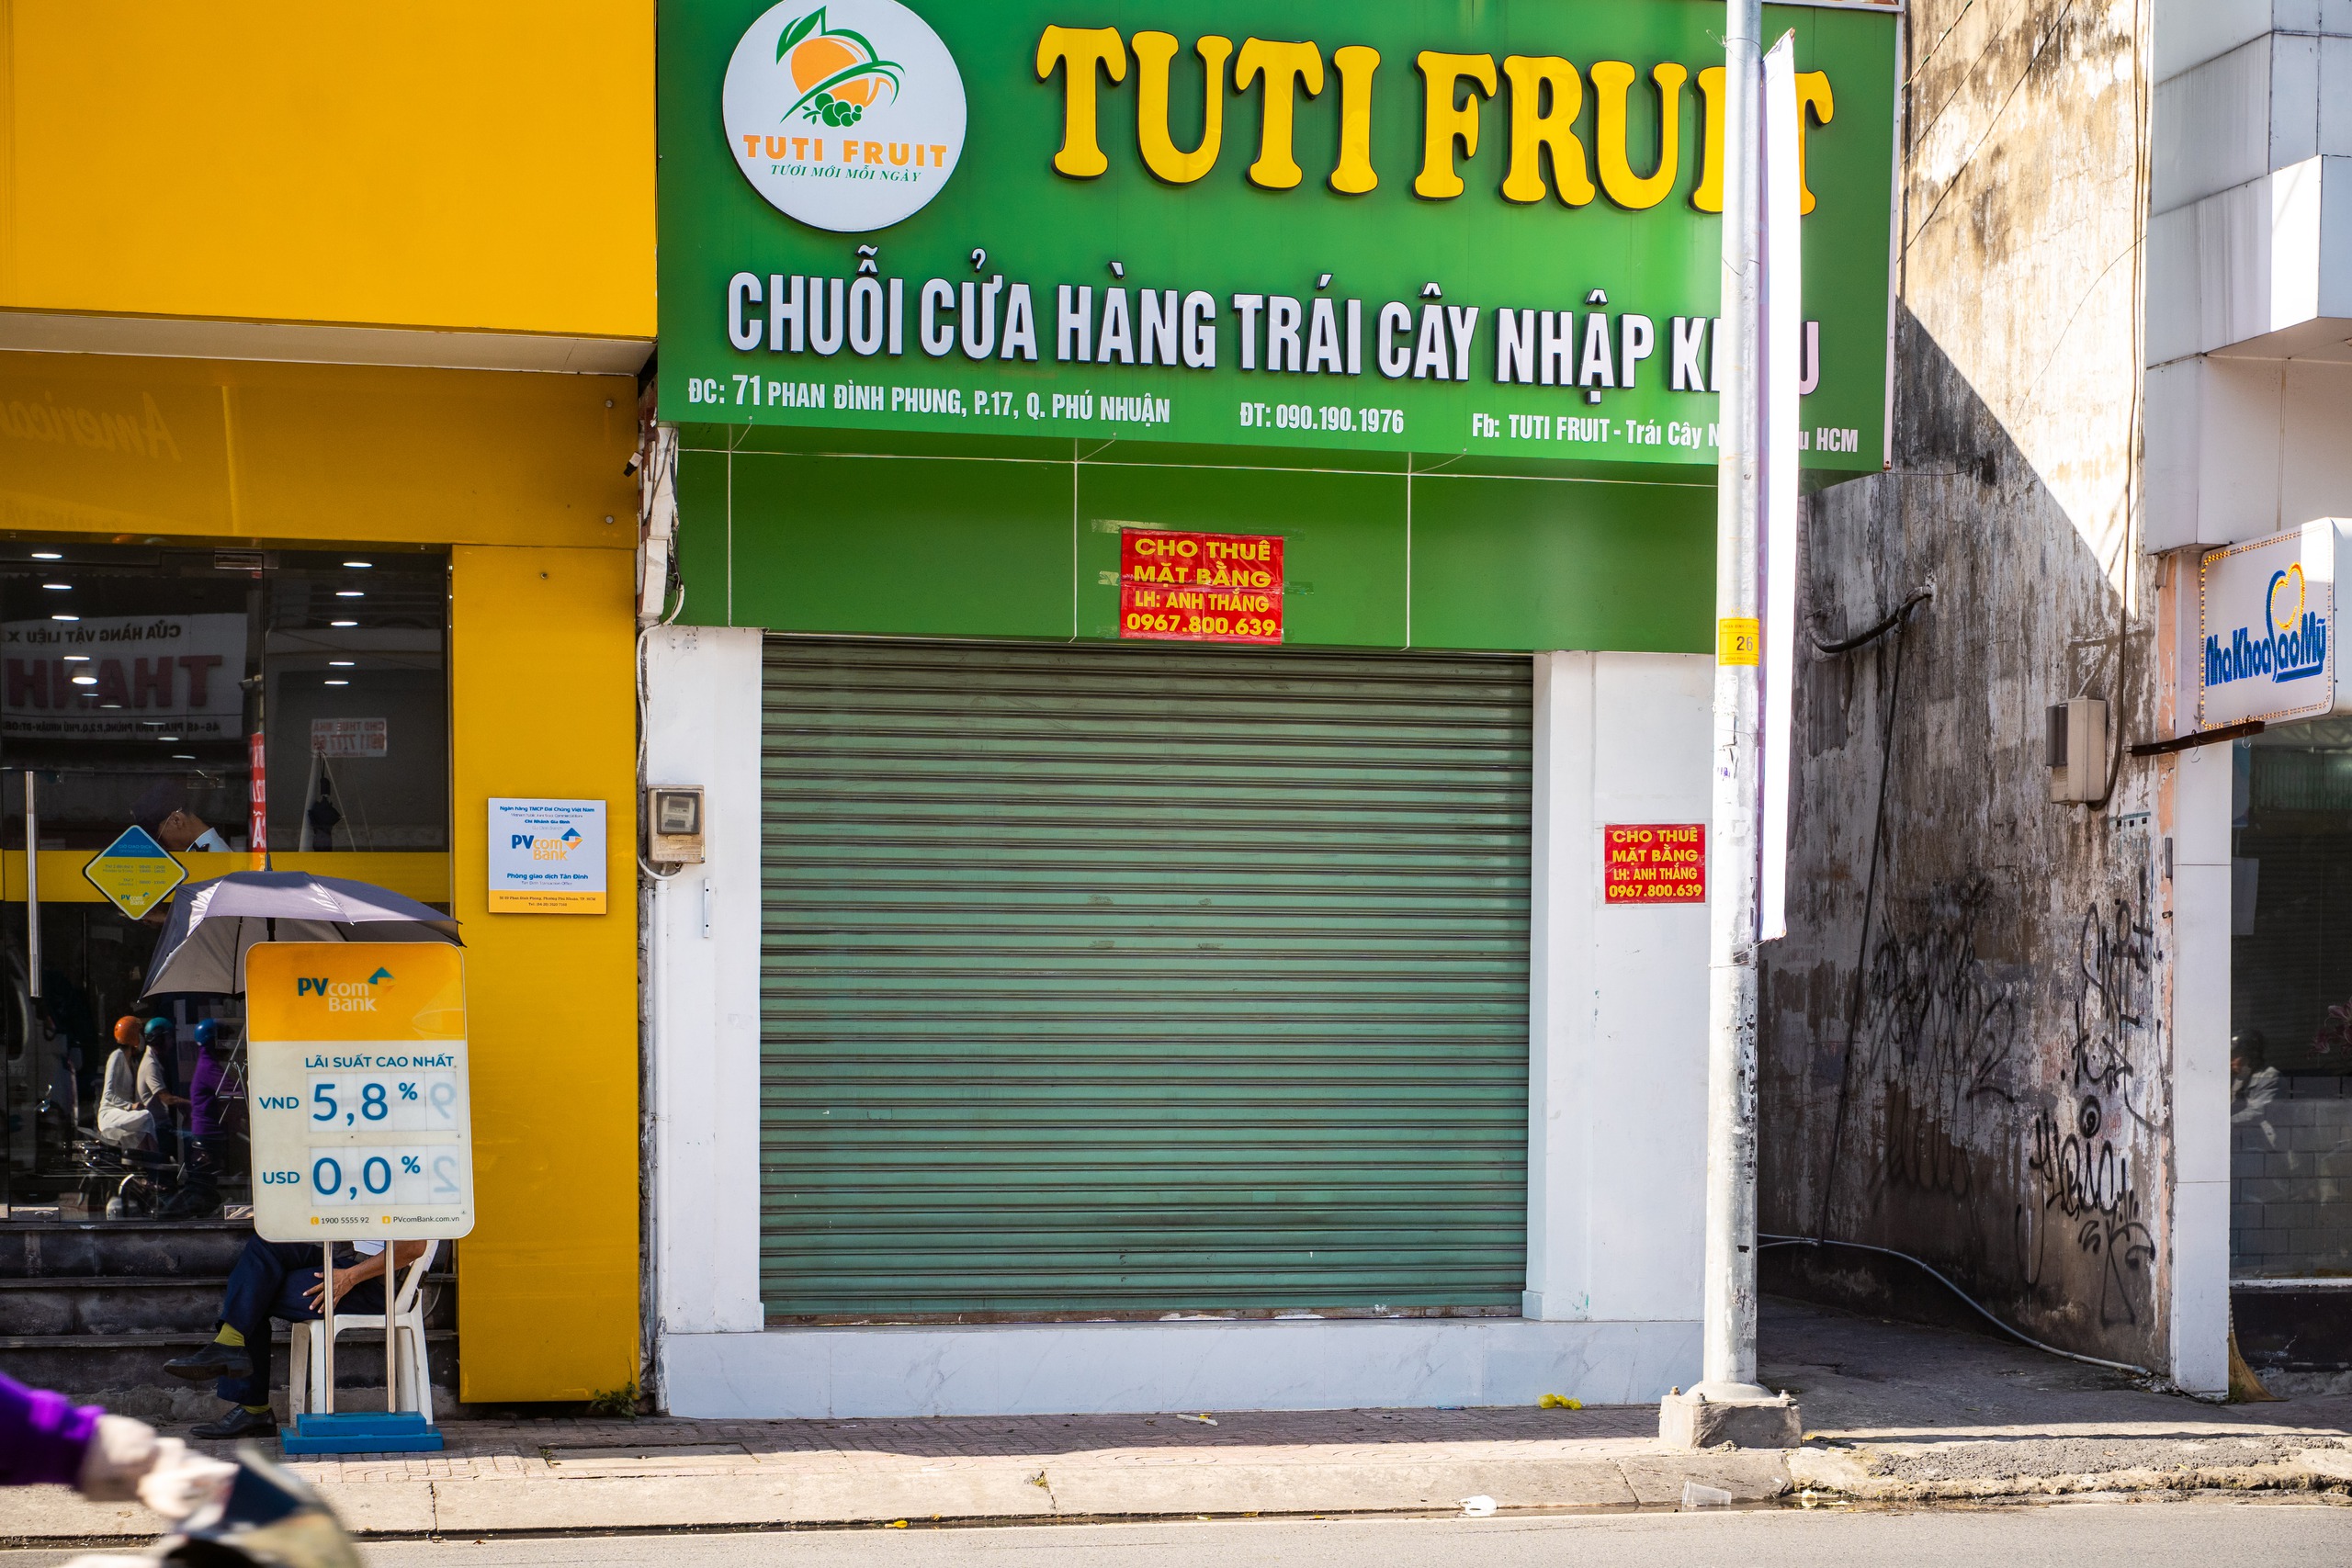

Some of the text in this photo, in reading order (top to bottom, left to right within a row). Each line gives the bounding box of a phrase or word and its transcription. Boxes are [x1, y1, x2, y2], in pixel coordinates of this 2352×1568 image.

[1035, 25, 1380, 194] TUTI
[743, 135, 947, 167] TUTI FRUIT
[771, 164, 922, 183] TƯƠI MỚI MỖI NGÀY
[728, 244, 1820, 404] CHUỖI CỬA HÀNG TRÁI CÂY NHẬP KU
[688, 374, 1170, 427] ĐC: 71 PHAN ĐÌNH PHUNG, P.17, Q. PHÚ NHUẬN
[1239, 401, 1405, 434] ĐT: 090.190.1976
[1472, 412, 1500, 438] Fb:
[1508, 413, 1551, 440] TUTI
[1555, 415, 1611, 443] FRUIT
[1667, 418, 1702, 450] Cây
[1815, 427, 1859, 453] HCM
[1135, 538, 1271, 561] CHO THUÊ
[1133, 560, 1272, 588] MẶT BẰNG
[1135, 587, 1270, 613] LH: ANH THẮNG
[1126, 613, 1276, 636] 0967.800.639
[1736, 635, 1754, 652] 26
[512, 834, 563, 850] PVcom
[1611, 827, 1698, 843] CHO THUÊ
[533, 850, 568, 861] Bank
[1612, 844, 1699, 865] MẶT BẰNG
[1613, 863, 1698, 881] LH: ANH THẮNG
[1609, 885, 1702, 897] 0967.800.639
[298, 977, 369, 997] PVcom
[328, 997, 377, 1011] Bank
[305, 1053, 454, 1068] LÃI SUẤT CAO NHẤT
[258, 1096, 300, 1110] VND
[263, 1171, 300, 1184] USD
[392, 1215, 460, 1224] PVcomBank.com.vn
